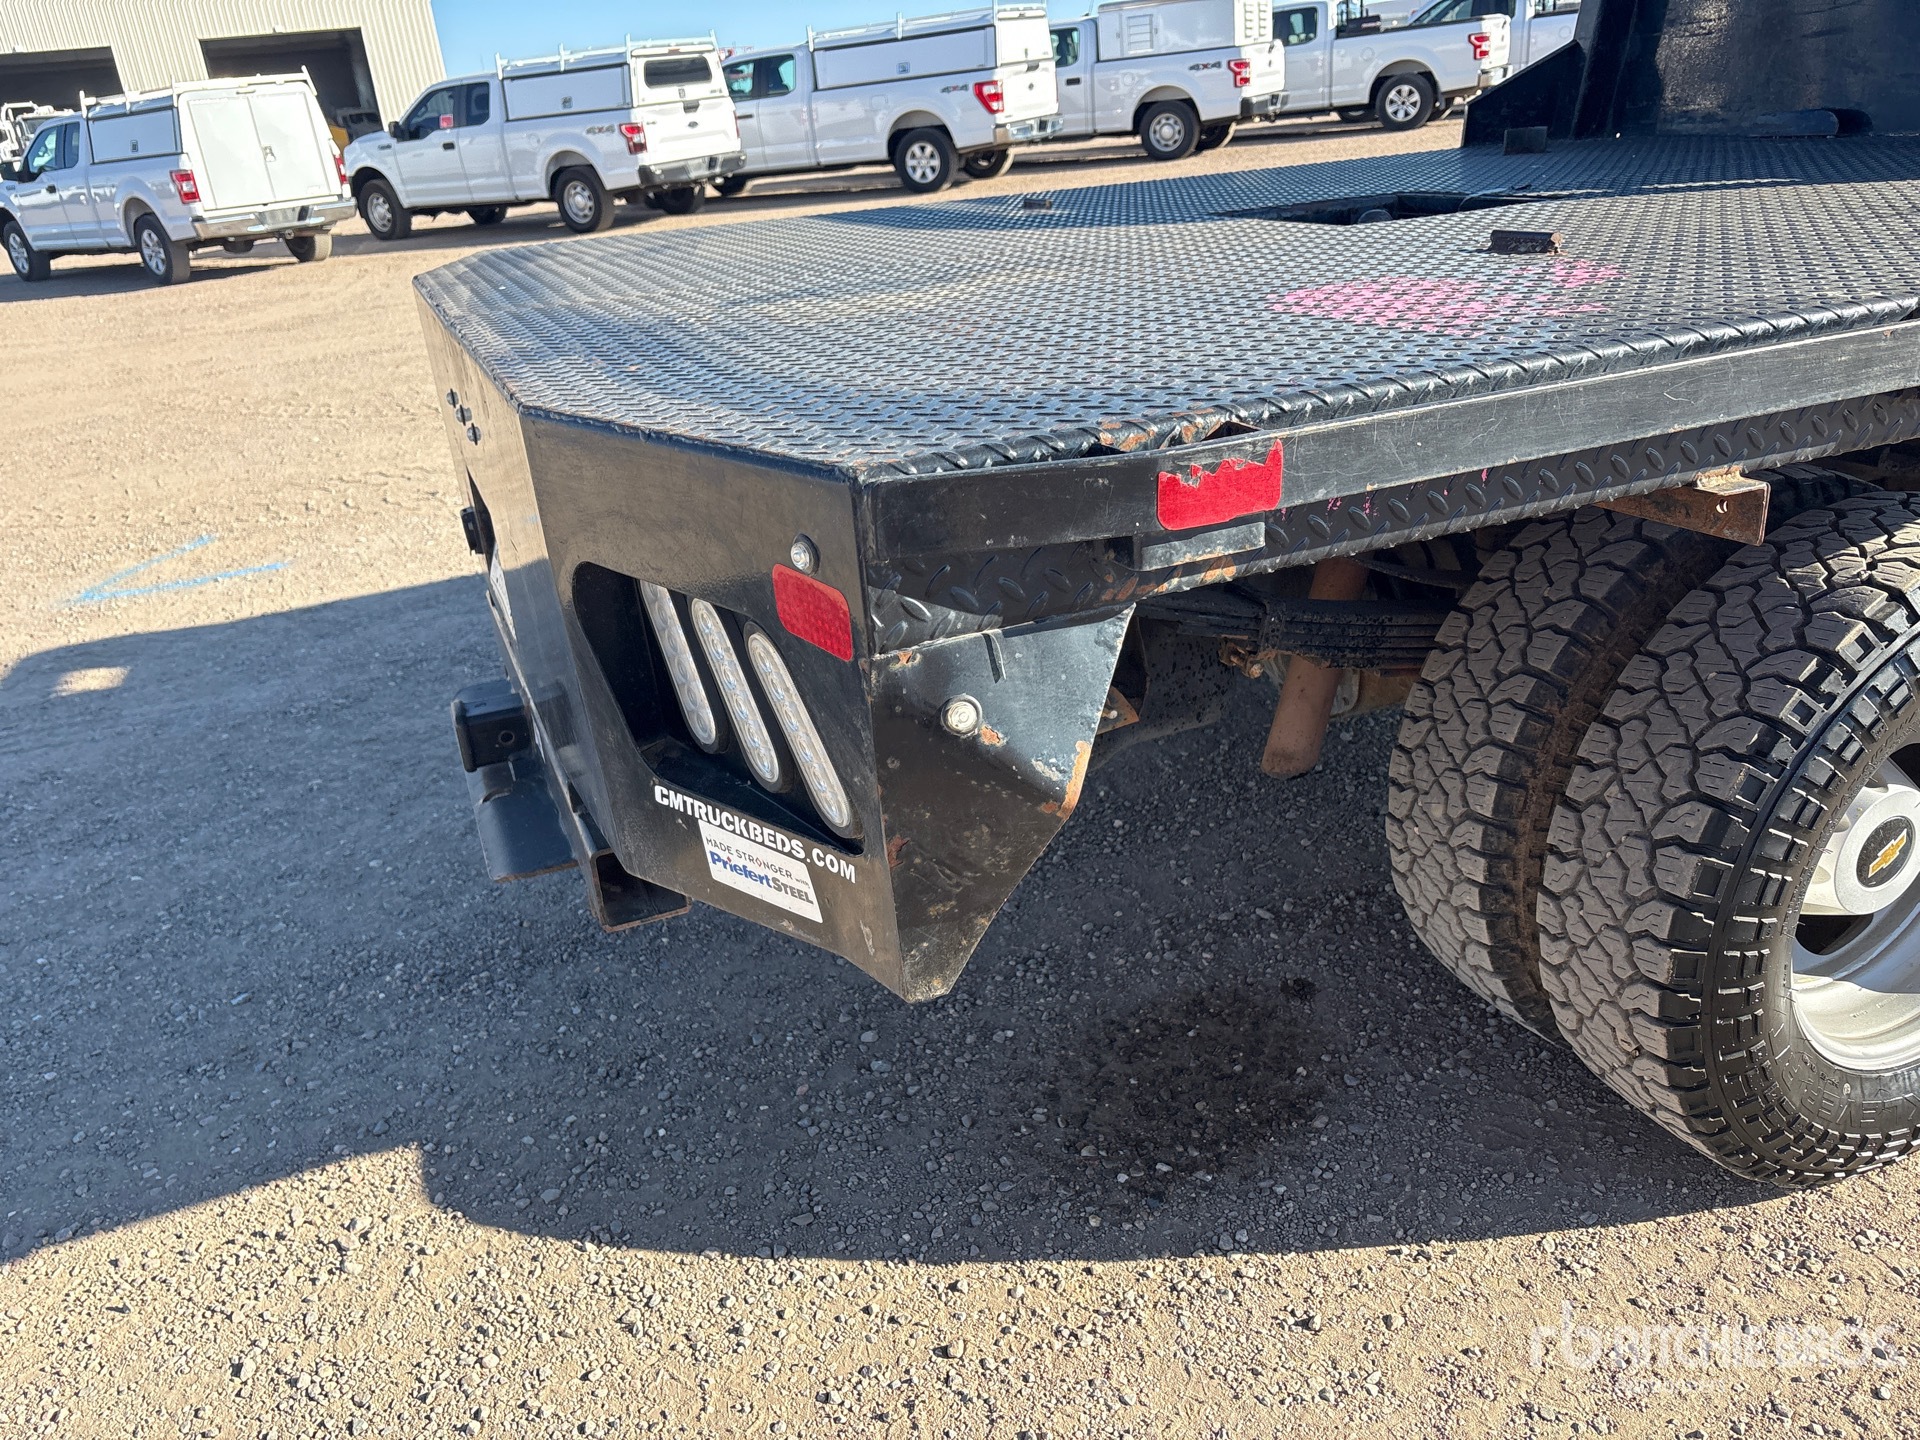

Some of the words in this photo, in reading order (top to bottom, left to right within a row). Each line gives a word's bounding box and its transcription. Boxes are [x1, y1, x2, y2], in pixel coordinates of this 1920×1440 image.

[654, 785, 856, 883] CMTRUCKBEDS.COM
[705, 836, 734, 856] MADE
[735, 849, 793, 880] STRONGER
